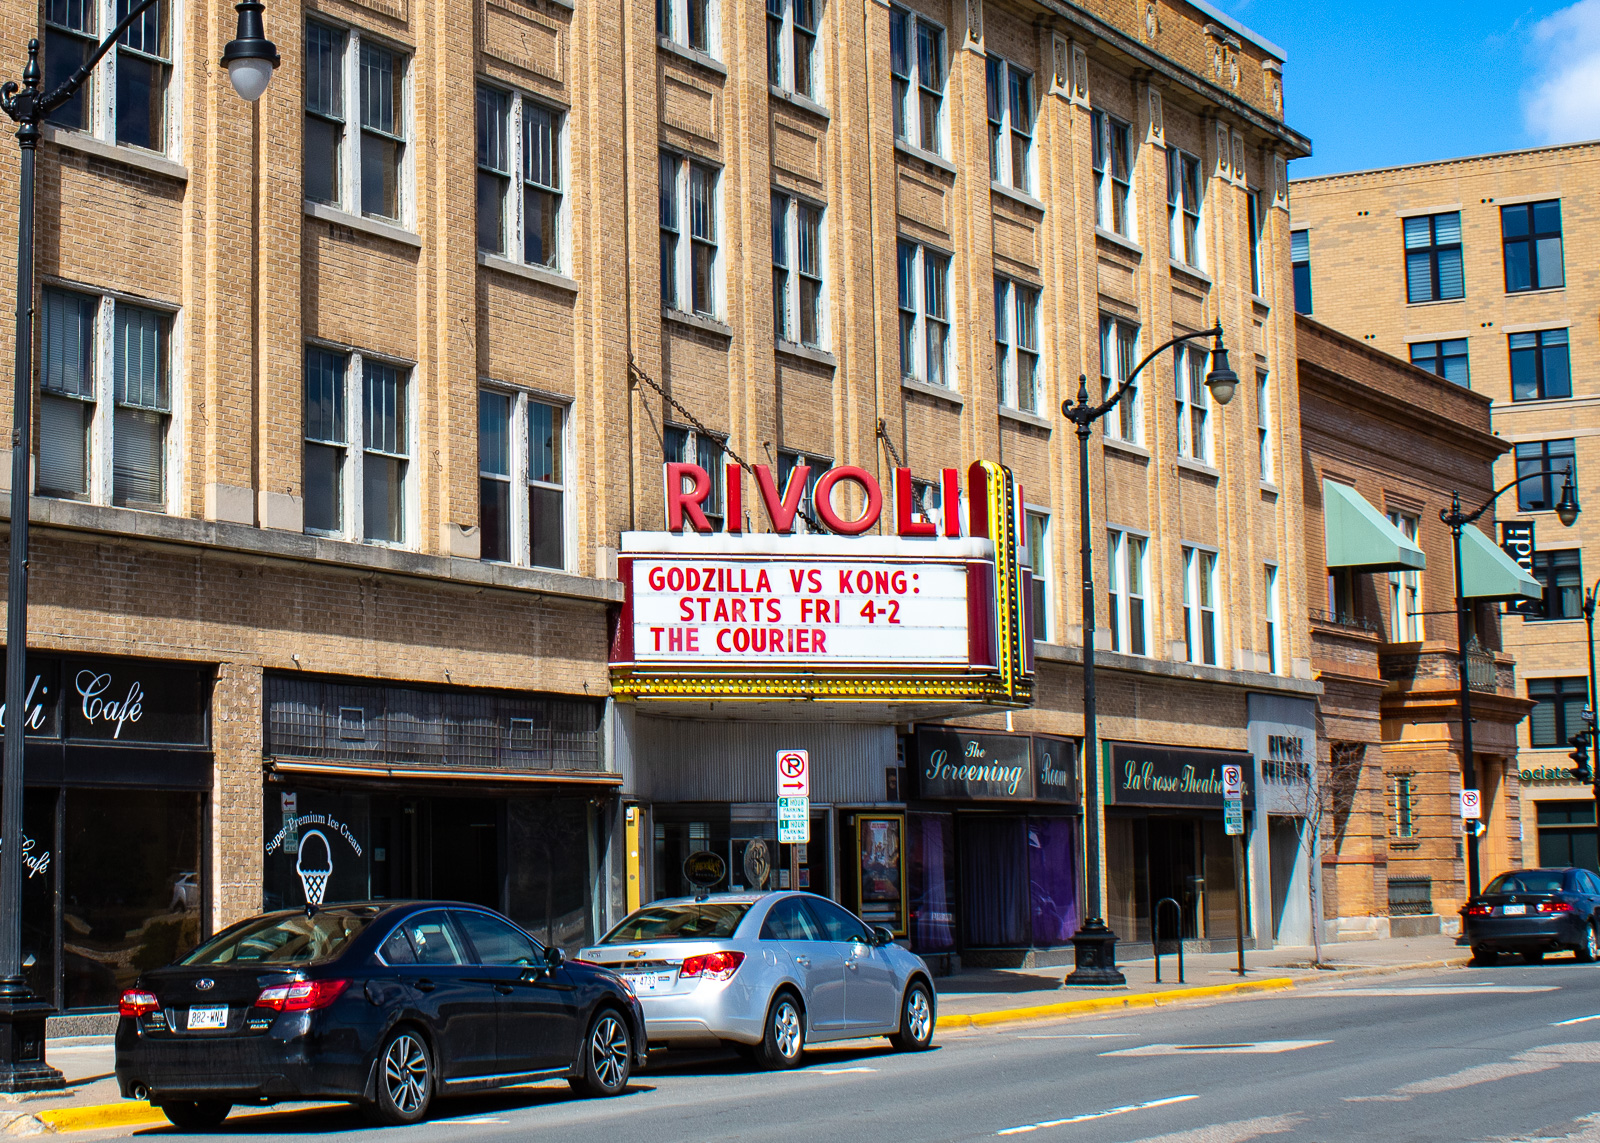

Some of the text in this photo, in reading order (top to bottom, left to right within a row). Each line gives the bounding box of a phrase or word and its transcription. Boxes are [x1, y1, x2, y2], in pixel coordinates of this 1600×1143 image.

[664, 462, 961, 538] RIVOLI
[648, 566, 920, 595] GODZILLA VS KONG:
[679, 596, 901, 624] STARTS FRI 4-2
[650, 626, 827, 653] THE COURIER
[75, 669, 144, 739] Café
[964, 740, 986, 758] The
[925, 749, 1068, 796] Screening Room
[265, 826, 288, 856] Super
[287, 810, 326, 832] Premium
[327, 813, 340, 831] Ice
[340, 823, 363, 857] Cream
